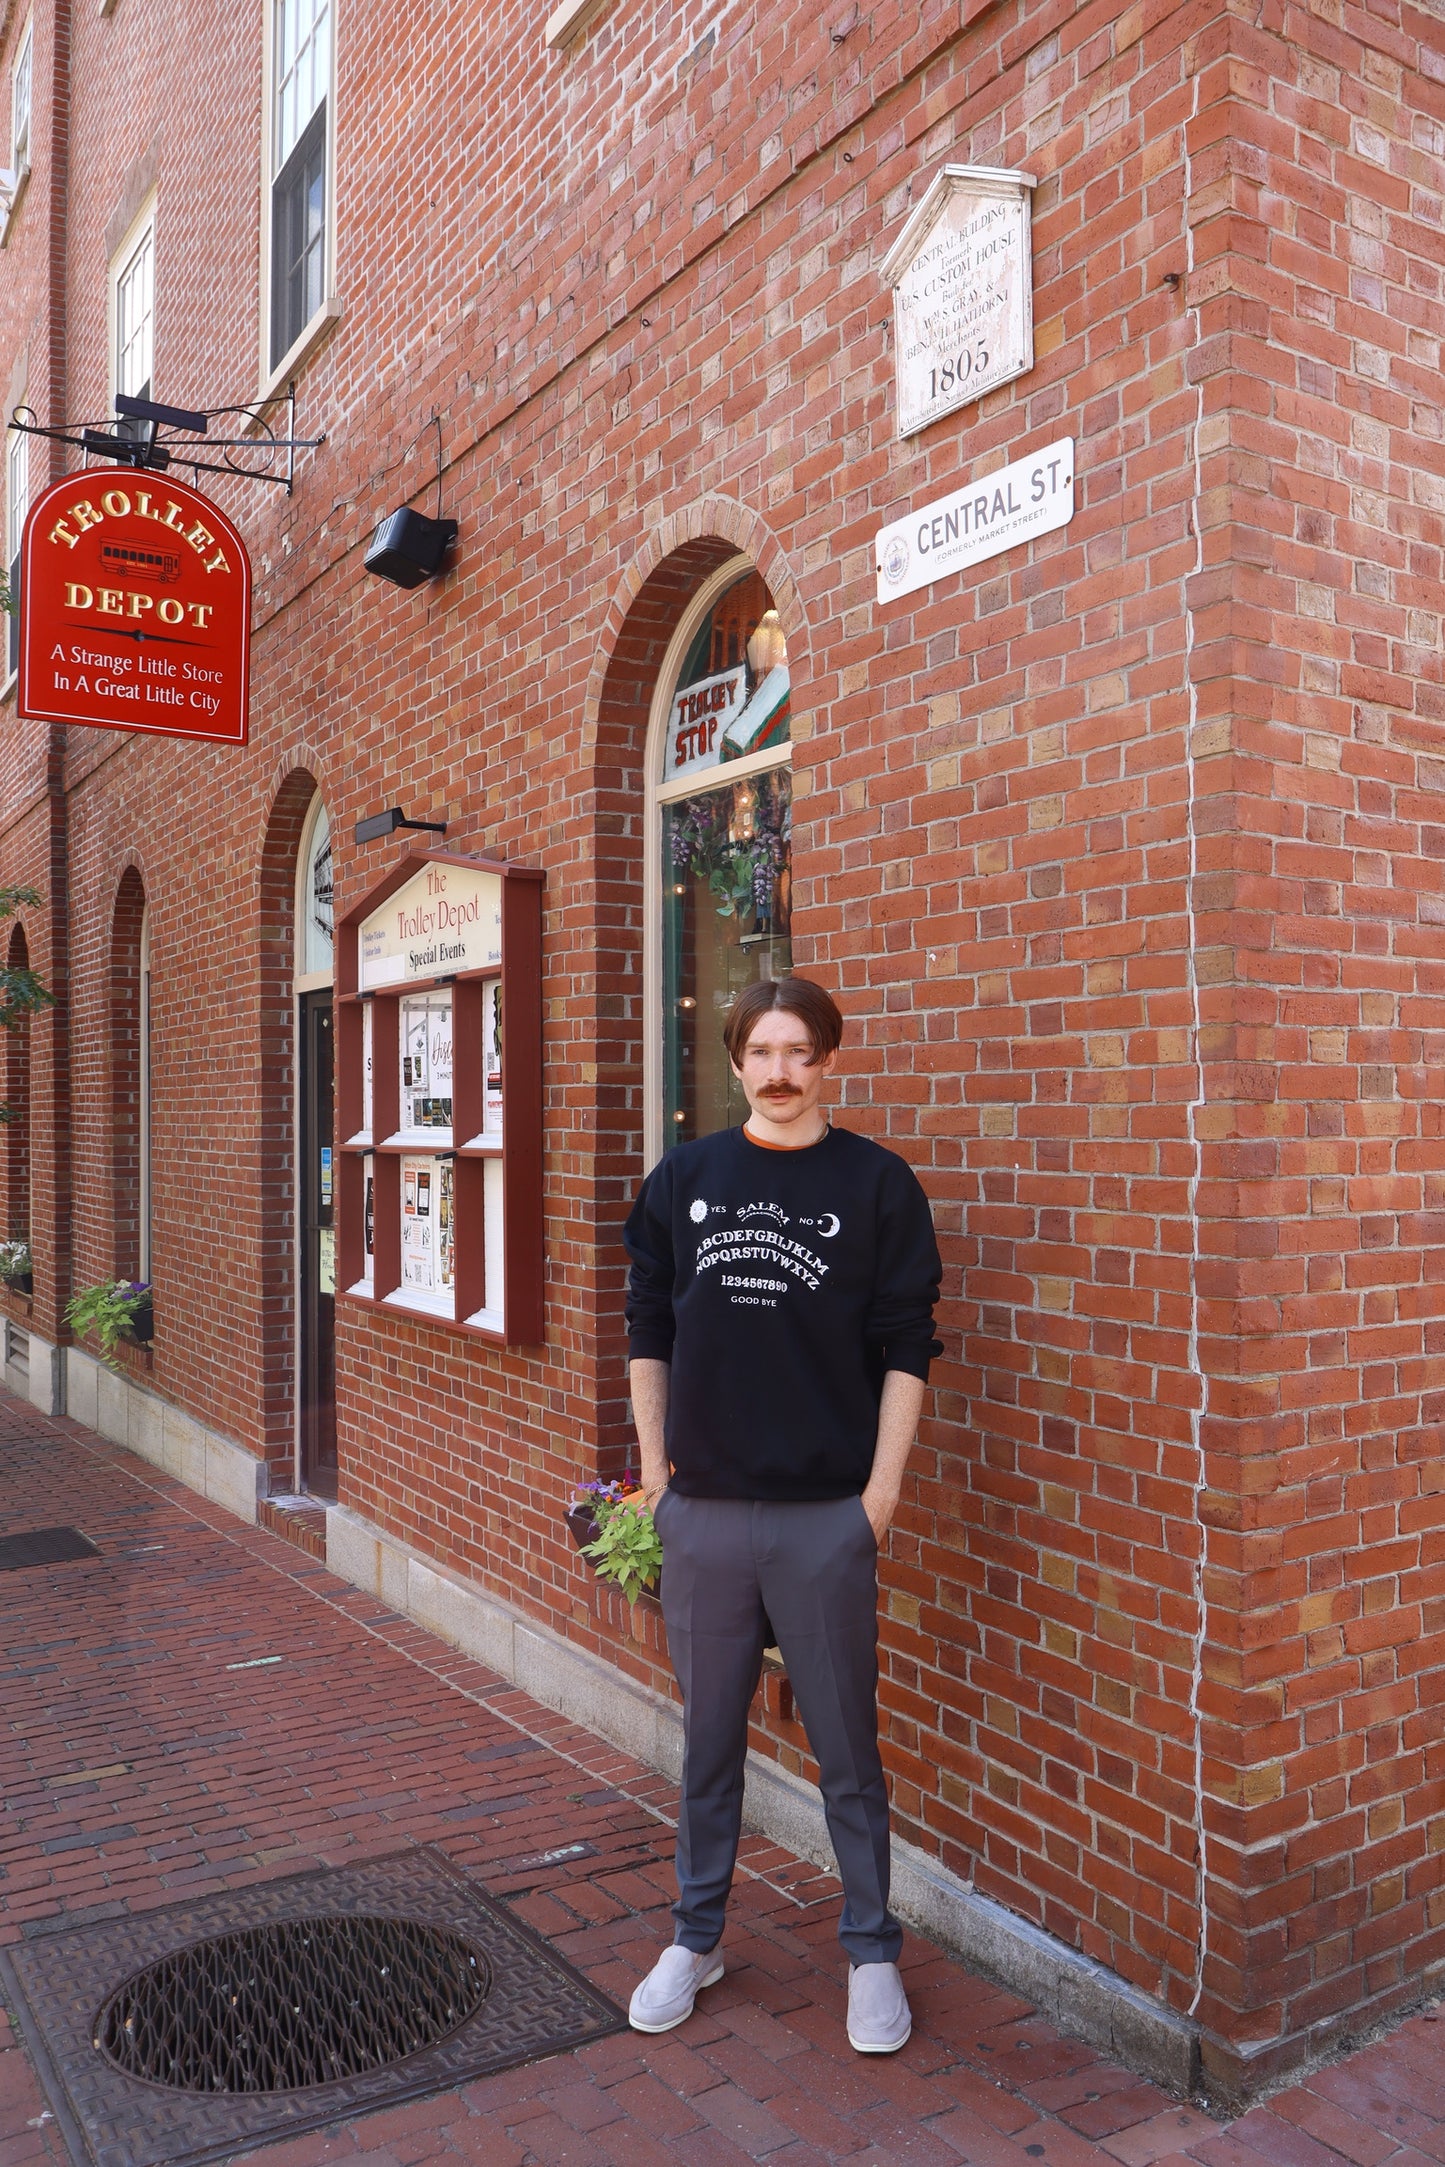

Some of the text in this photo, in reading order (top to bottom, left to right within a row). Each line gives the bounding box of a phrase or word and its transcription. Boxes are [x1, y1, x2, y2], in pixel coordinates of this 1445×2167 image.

[959, 202, 1006, 243] BUILDING
[924, 257, 971, 298] CUSTOM
[976, 228, 1015, 265] HOUSE
[928, 338, 989, 401] 1805
[917, 459, 1067, 555] CENTRAL ST.
[47, 489, 231, 576] TROLLEY
[934, 538, 978, 565] (FORMERLY
[978, 522, 1010, 544] MARKET
[1013, 507, 1048, 530] STREET)
[64, 581, 213, 629] DEPOT
[50, 643, 223, 684] A Strange Little Store
[53, 671, 221, 716] In A Great Little City
[677, 678, 738, 726] TROLLEY
[674, 716, 718, 767] STOP
[426, 868, 447, 896] The
[397, 893, 480, 942] Trolley Depot
[409, 941, 466, 971] Special Events
[736, 1202, 790, 1225] SALEM
[799, 1218, 814, 1226] NO
[696, 1229, 830, 1276] ABCDEFGHIJKLM
[696, 1247, 821, 1290] NOPQRSTUVWXYZ
[721, 1275, 788, 1292] 1234567890
[730, 1296, 777, 1307] GOOD BYE
